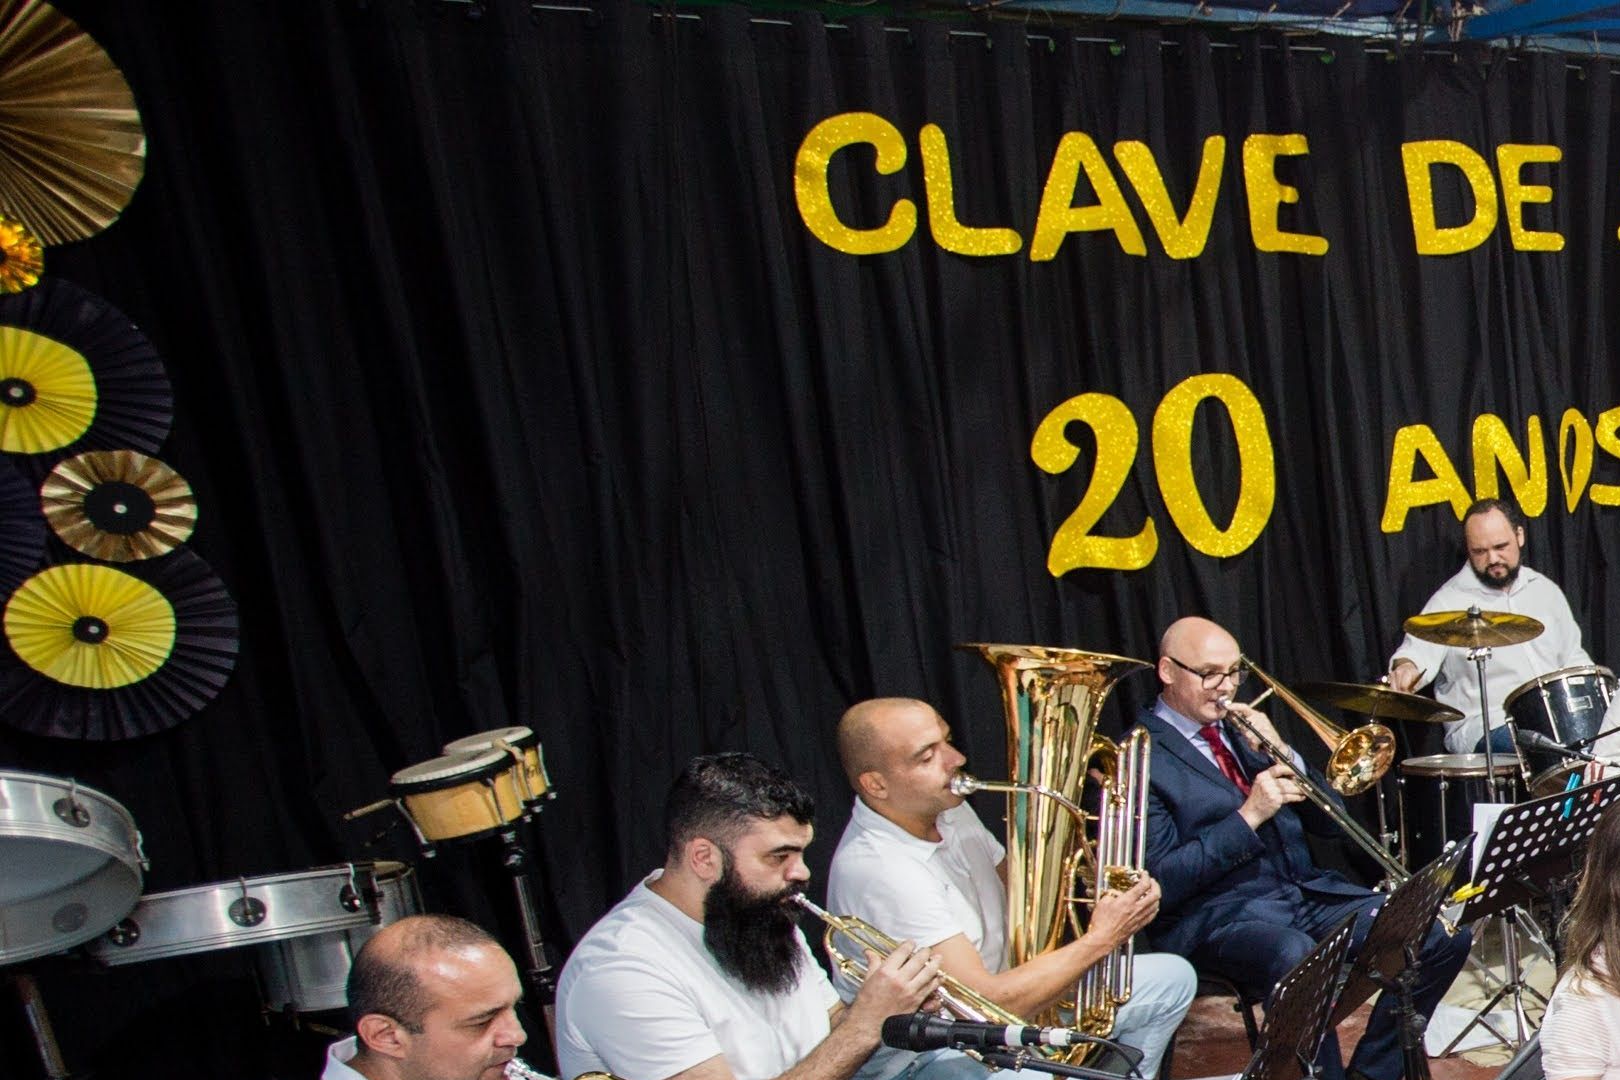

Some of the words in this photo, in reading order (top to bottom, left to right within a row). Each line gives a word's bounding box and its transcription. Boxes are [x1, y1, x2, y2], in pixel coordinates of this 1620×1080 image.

[794, 112, 1329, 261] CLAVE
[1401, 139, 1565, 255] DE
[1031, 373, 1275, 578] 20
